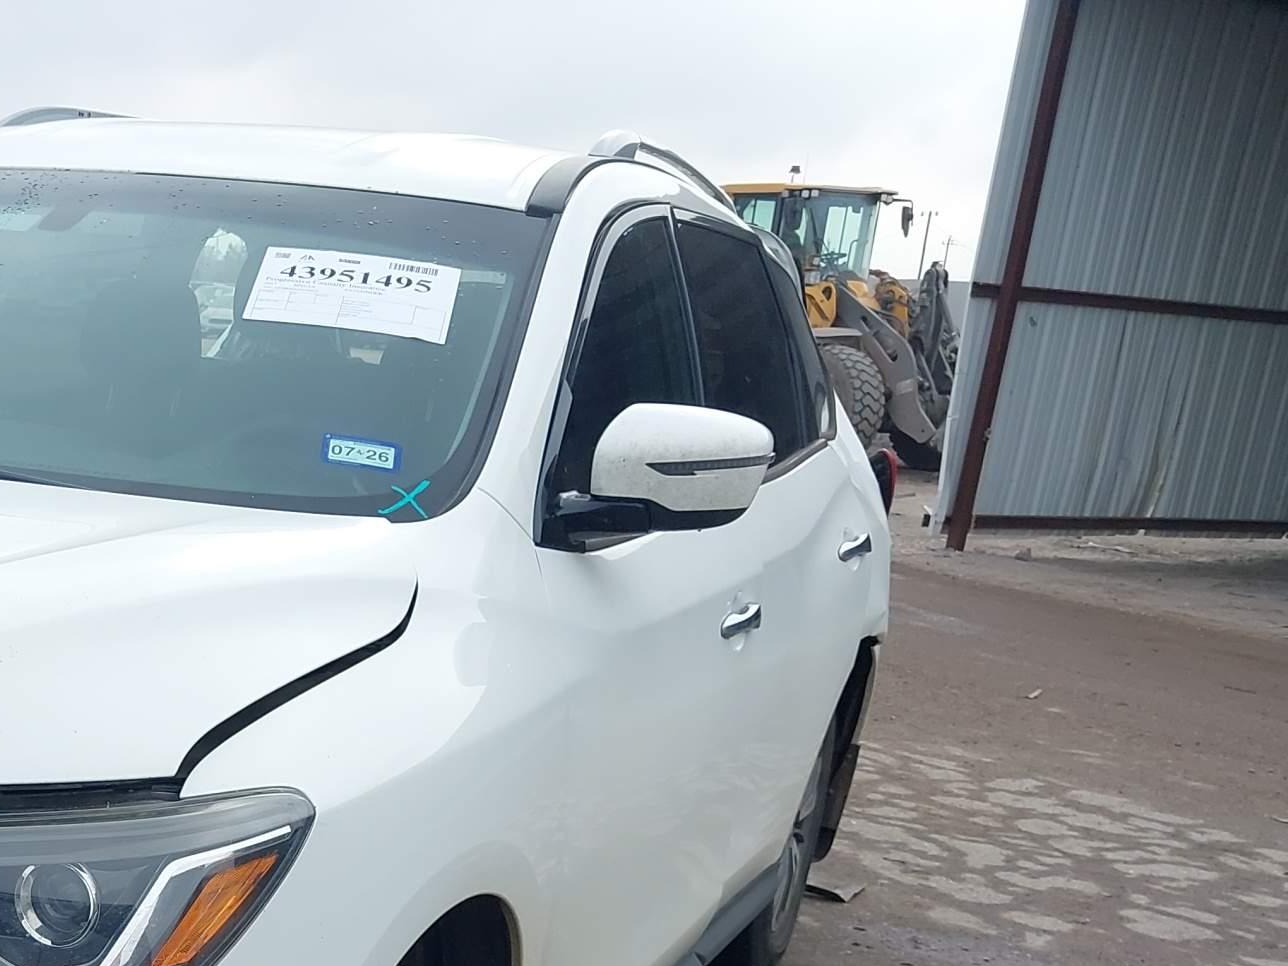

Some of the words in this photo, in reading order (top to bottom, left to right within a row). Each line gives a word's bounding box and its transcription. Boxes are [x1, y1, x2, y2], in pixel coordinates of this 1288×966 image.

[279, 265, 432, 293] 43951495
[331, 445, 355, 457] 07
[365, 449, 390, 463] 26
